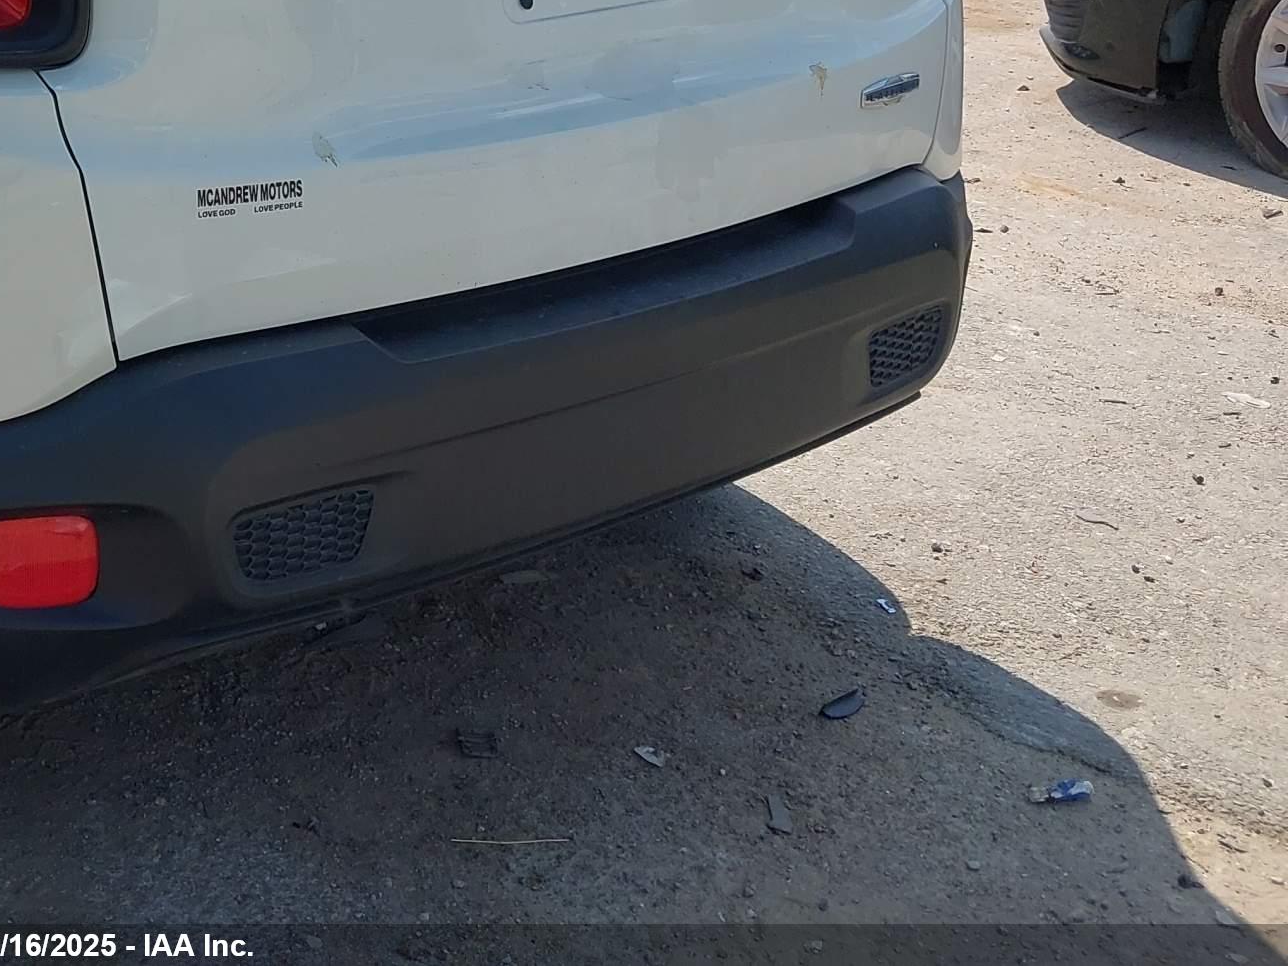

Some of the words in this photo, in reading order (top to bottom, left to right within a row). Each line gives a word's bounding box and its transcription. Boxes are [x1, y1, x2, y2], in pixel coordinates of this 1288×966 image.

[197, 183, 259, 208] MCANDREW
[260, 179, 303, 202] MOTORS
[253, 204, 274, 213] LOVE
[274, 201, 303, 211] PEOPLE
[197, 209, 218, 219] LOVE
[218, 208, 236, 217] GOD
